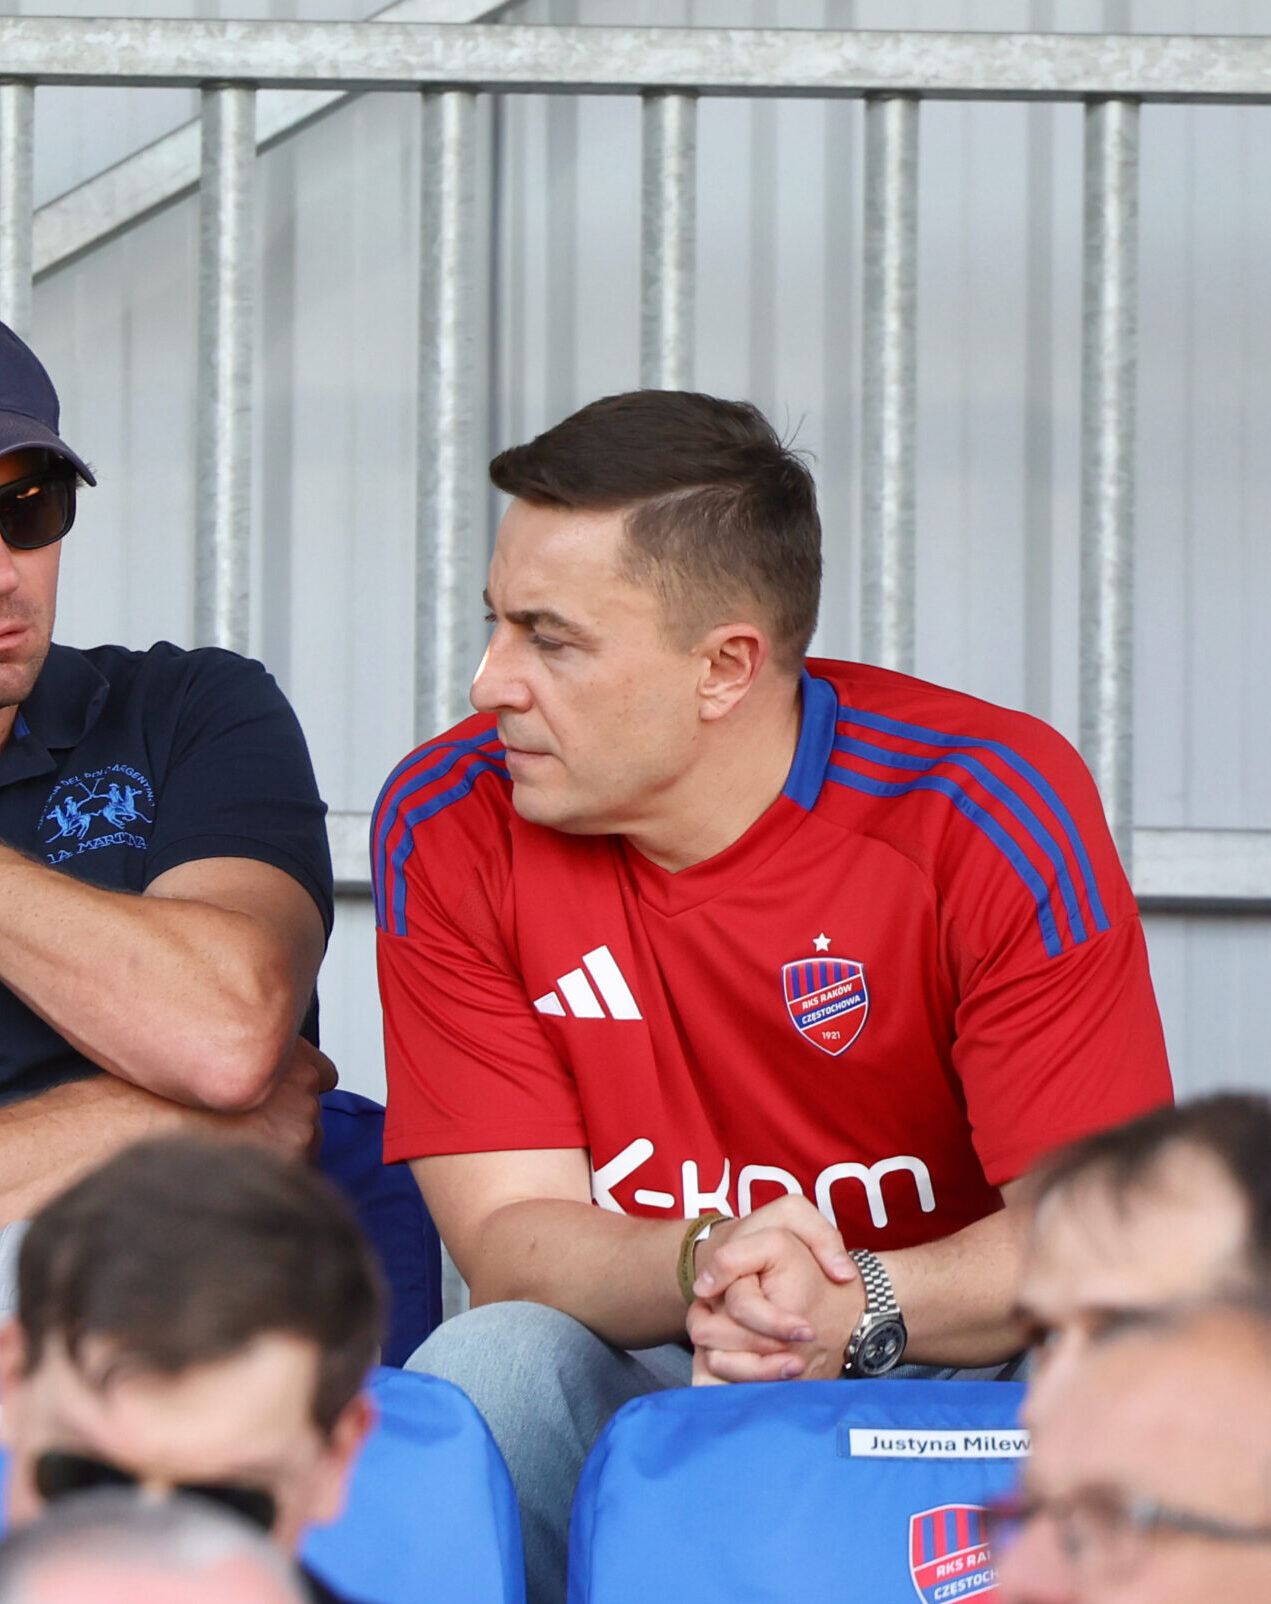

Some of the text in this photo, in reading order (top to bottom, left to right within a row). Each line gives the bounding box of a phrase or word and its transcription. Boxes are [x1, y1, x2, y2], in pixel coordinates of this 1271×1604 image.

[801, 982, 853, 1010] RKS RAKÓW
[801, 995, 862, 1025] CZĘSTOCHOWA
[821, 1031, 841, 1040] 1921
[871, 1436, 1032, 1454] Justyna Milew
[936, 1557, 964, 1578] RKS
